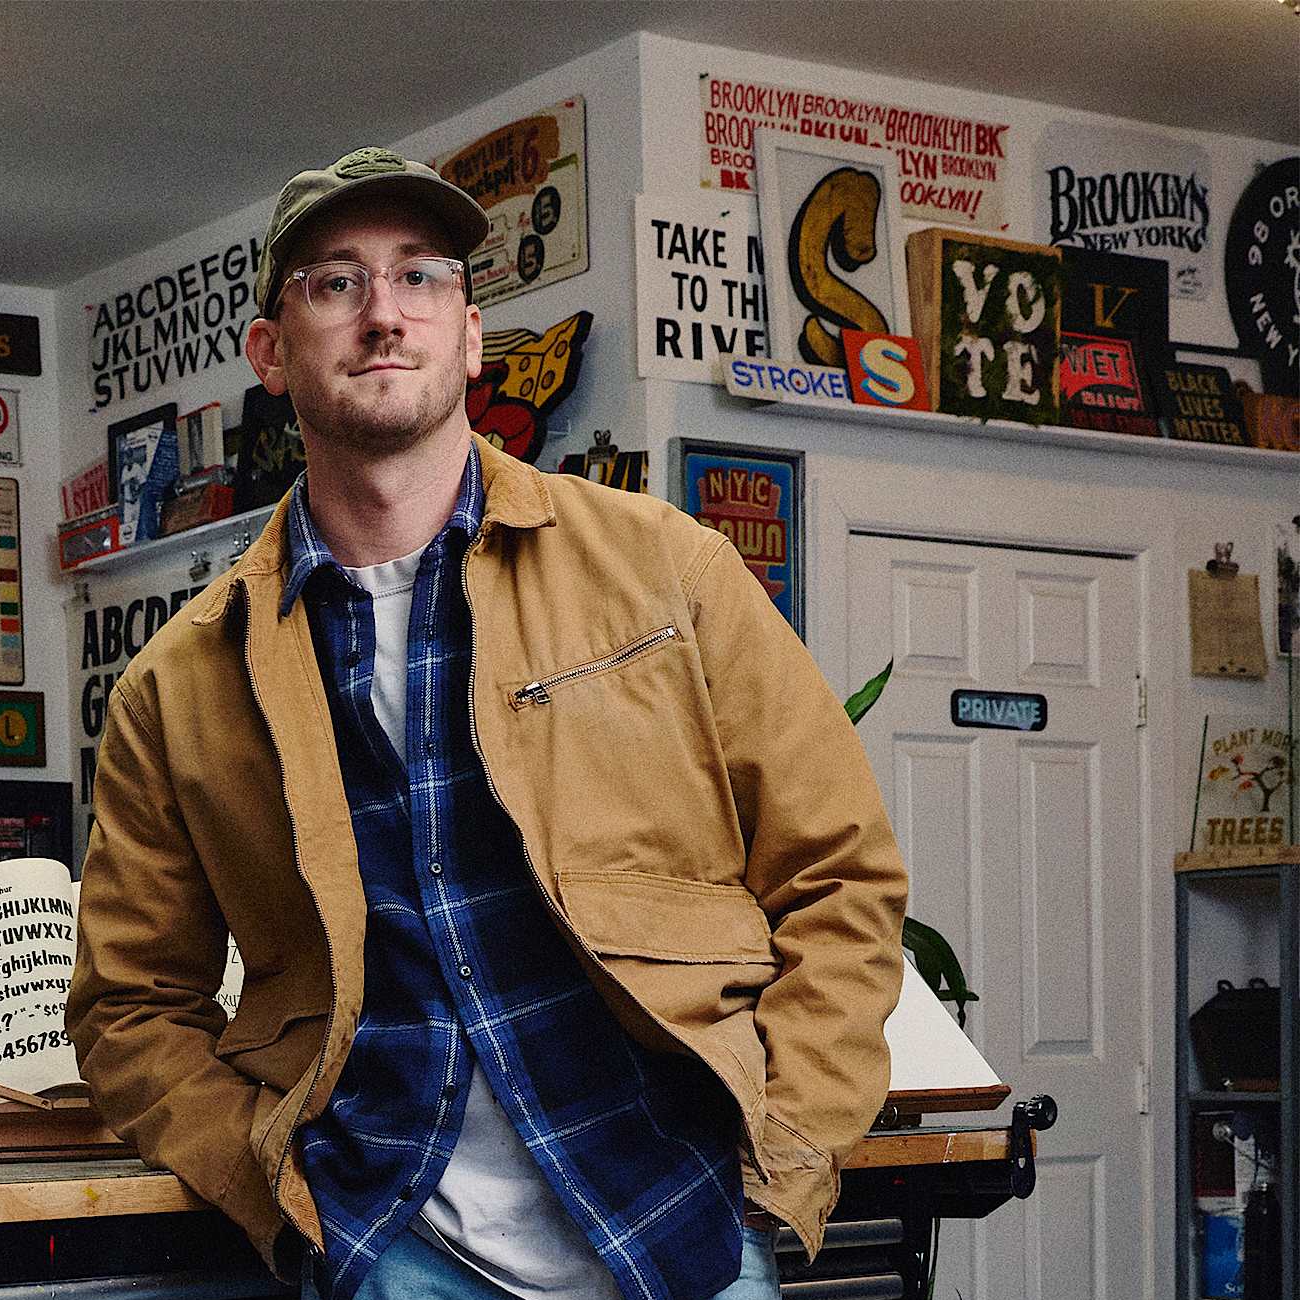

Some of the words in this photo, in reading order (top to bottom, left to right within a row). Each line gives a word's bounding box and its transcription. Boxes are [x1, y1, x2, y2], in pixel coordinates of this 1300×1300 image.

[710, 79, 800, 120] BROOKLYN
[803, 92, 888, 127] BROOKLYN
[886, 107, 972, 150] BROOKLYN
[896, 147, 937, 180] LYN
[651, 219, 727, 268] TAKE
[671, 271, 708, 312] TO
[722, 279, 769, 322] TH
[1089, 283, 1139, 330] V
[1250, 292, 1283, 350] NEW
[91, 281, 260, 371] JKLMNOP
[731, 359, 852, 400] STROKE
[859, 338, 915, 406] S
[710, 471, 771, 502] NYC
[81, 583, 209, 670] ABCD
[957, 696, 1042, 724] PRIVATE
[1206, 815, 1286, 846] TREES
